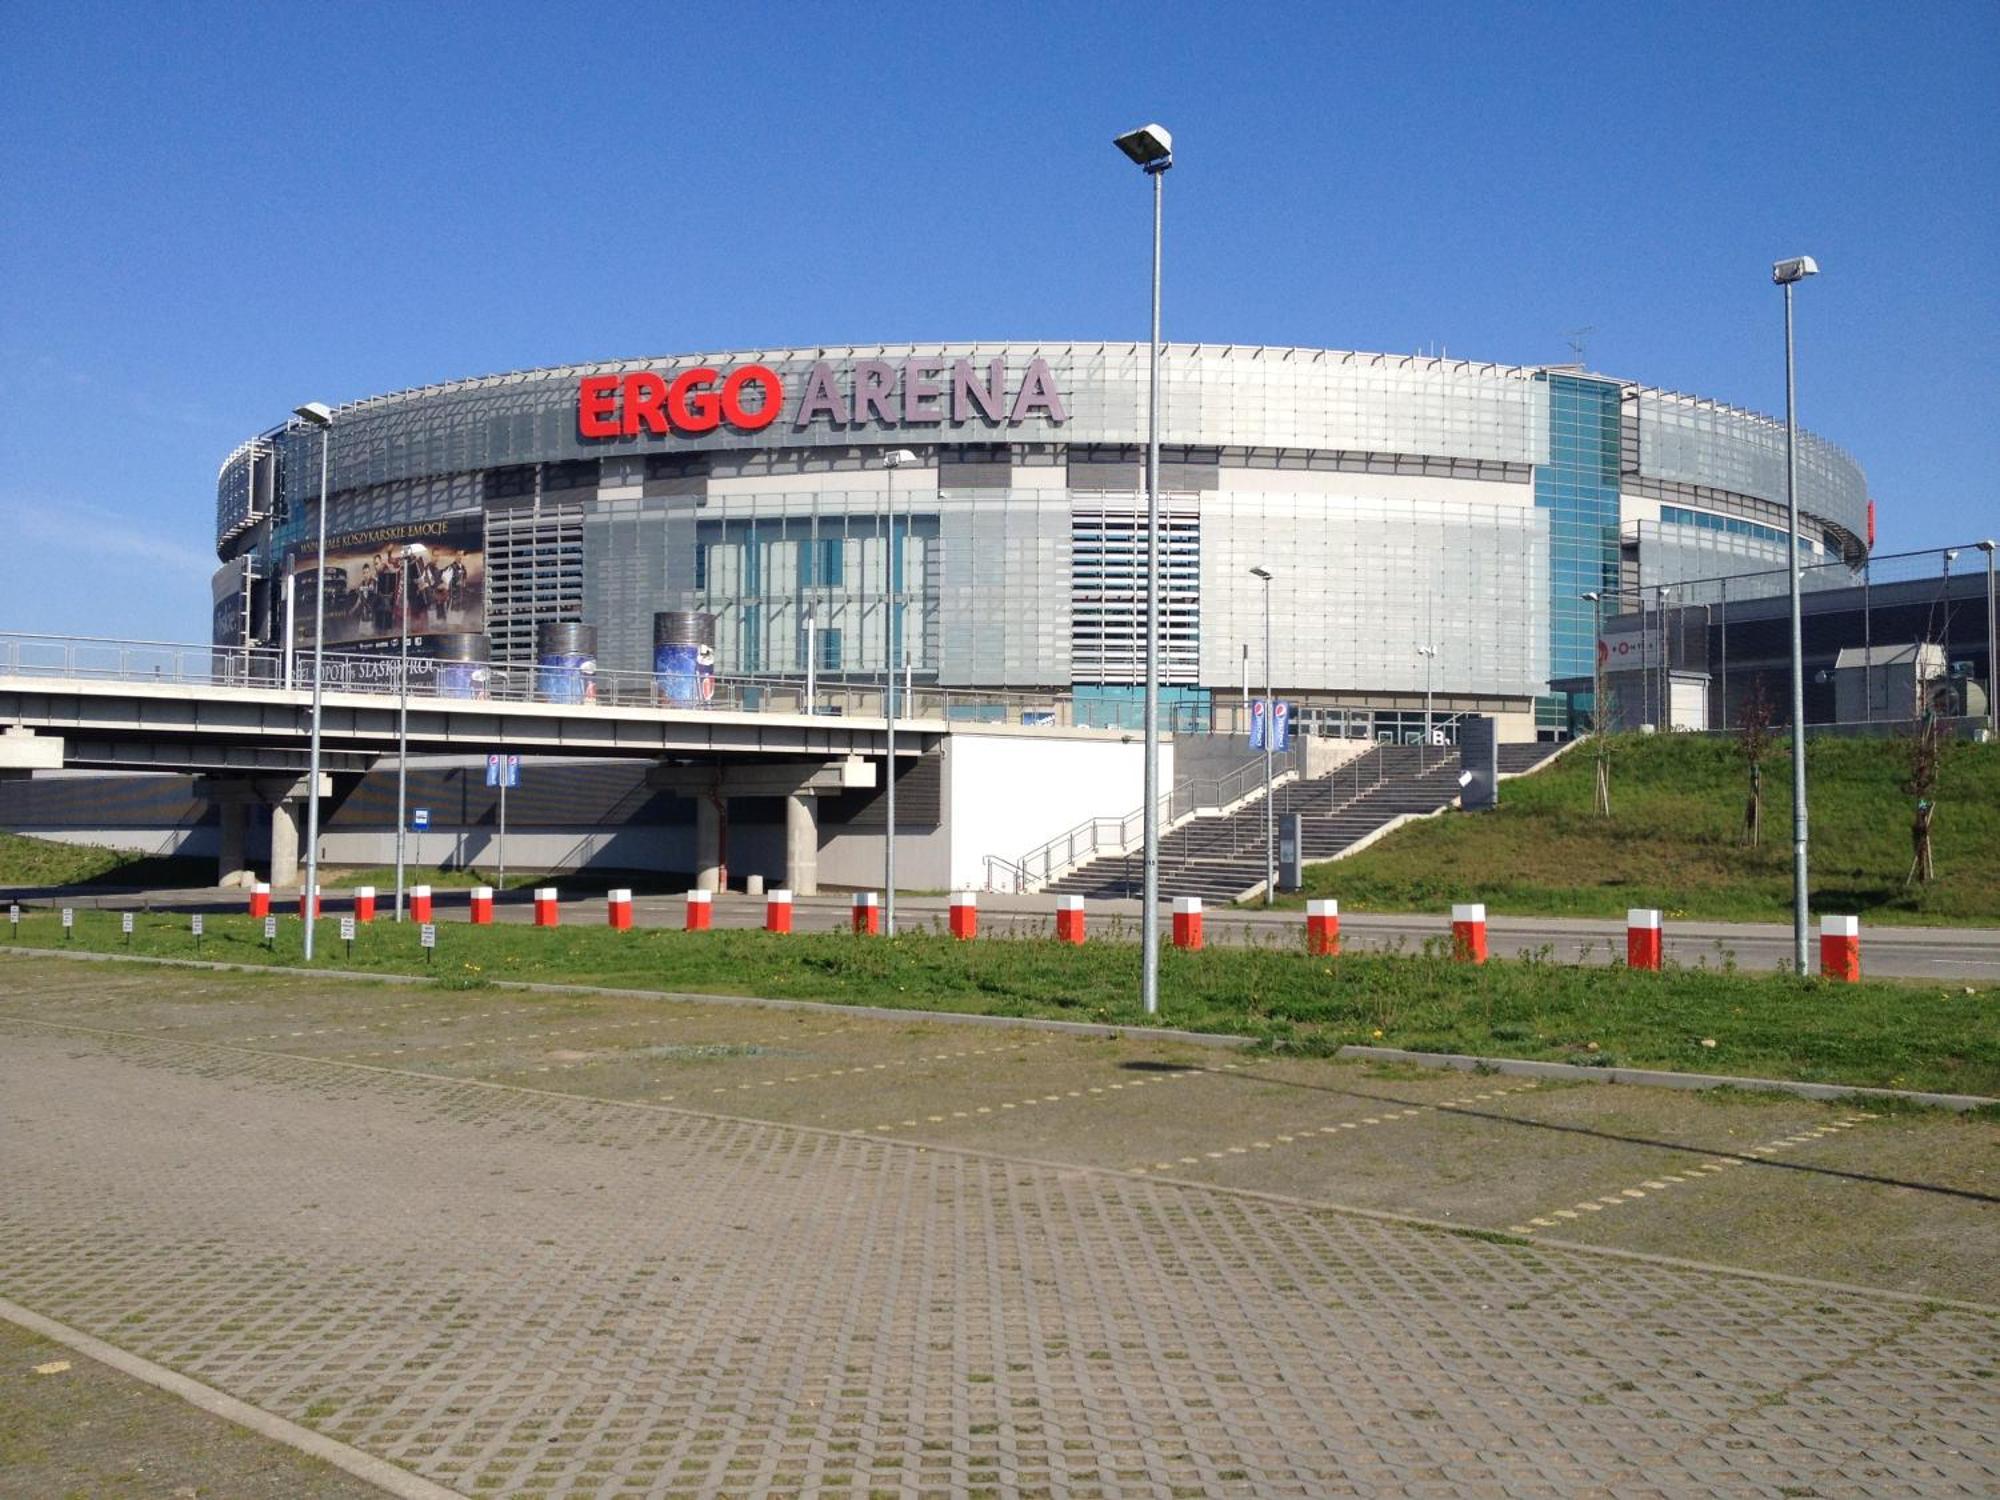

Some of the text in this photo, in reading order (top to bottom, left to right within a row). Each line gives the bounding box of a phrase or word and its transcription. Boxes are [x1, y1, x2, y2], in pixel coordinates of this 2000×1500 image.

[578, 357, 1069, 437] ERGO ARENA
[408, 520, 449, 537] EMOCJE
